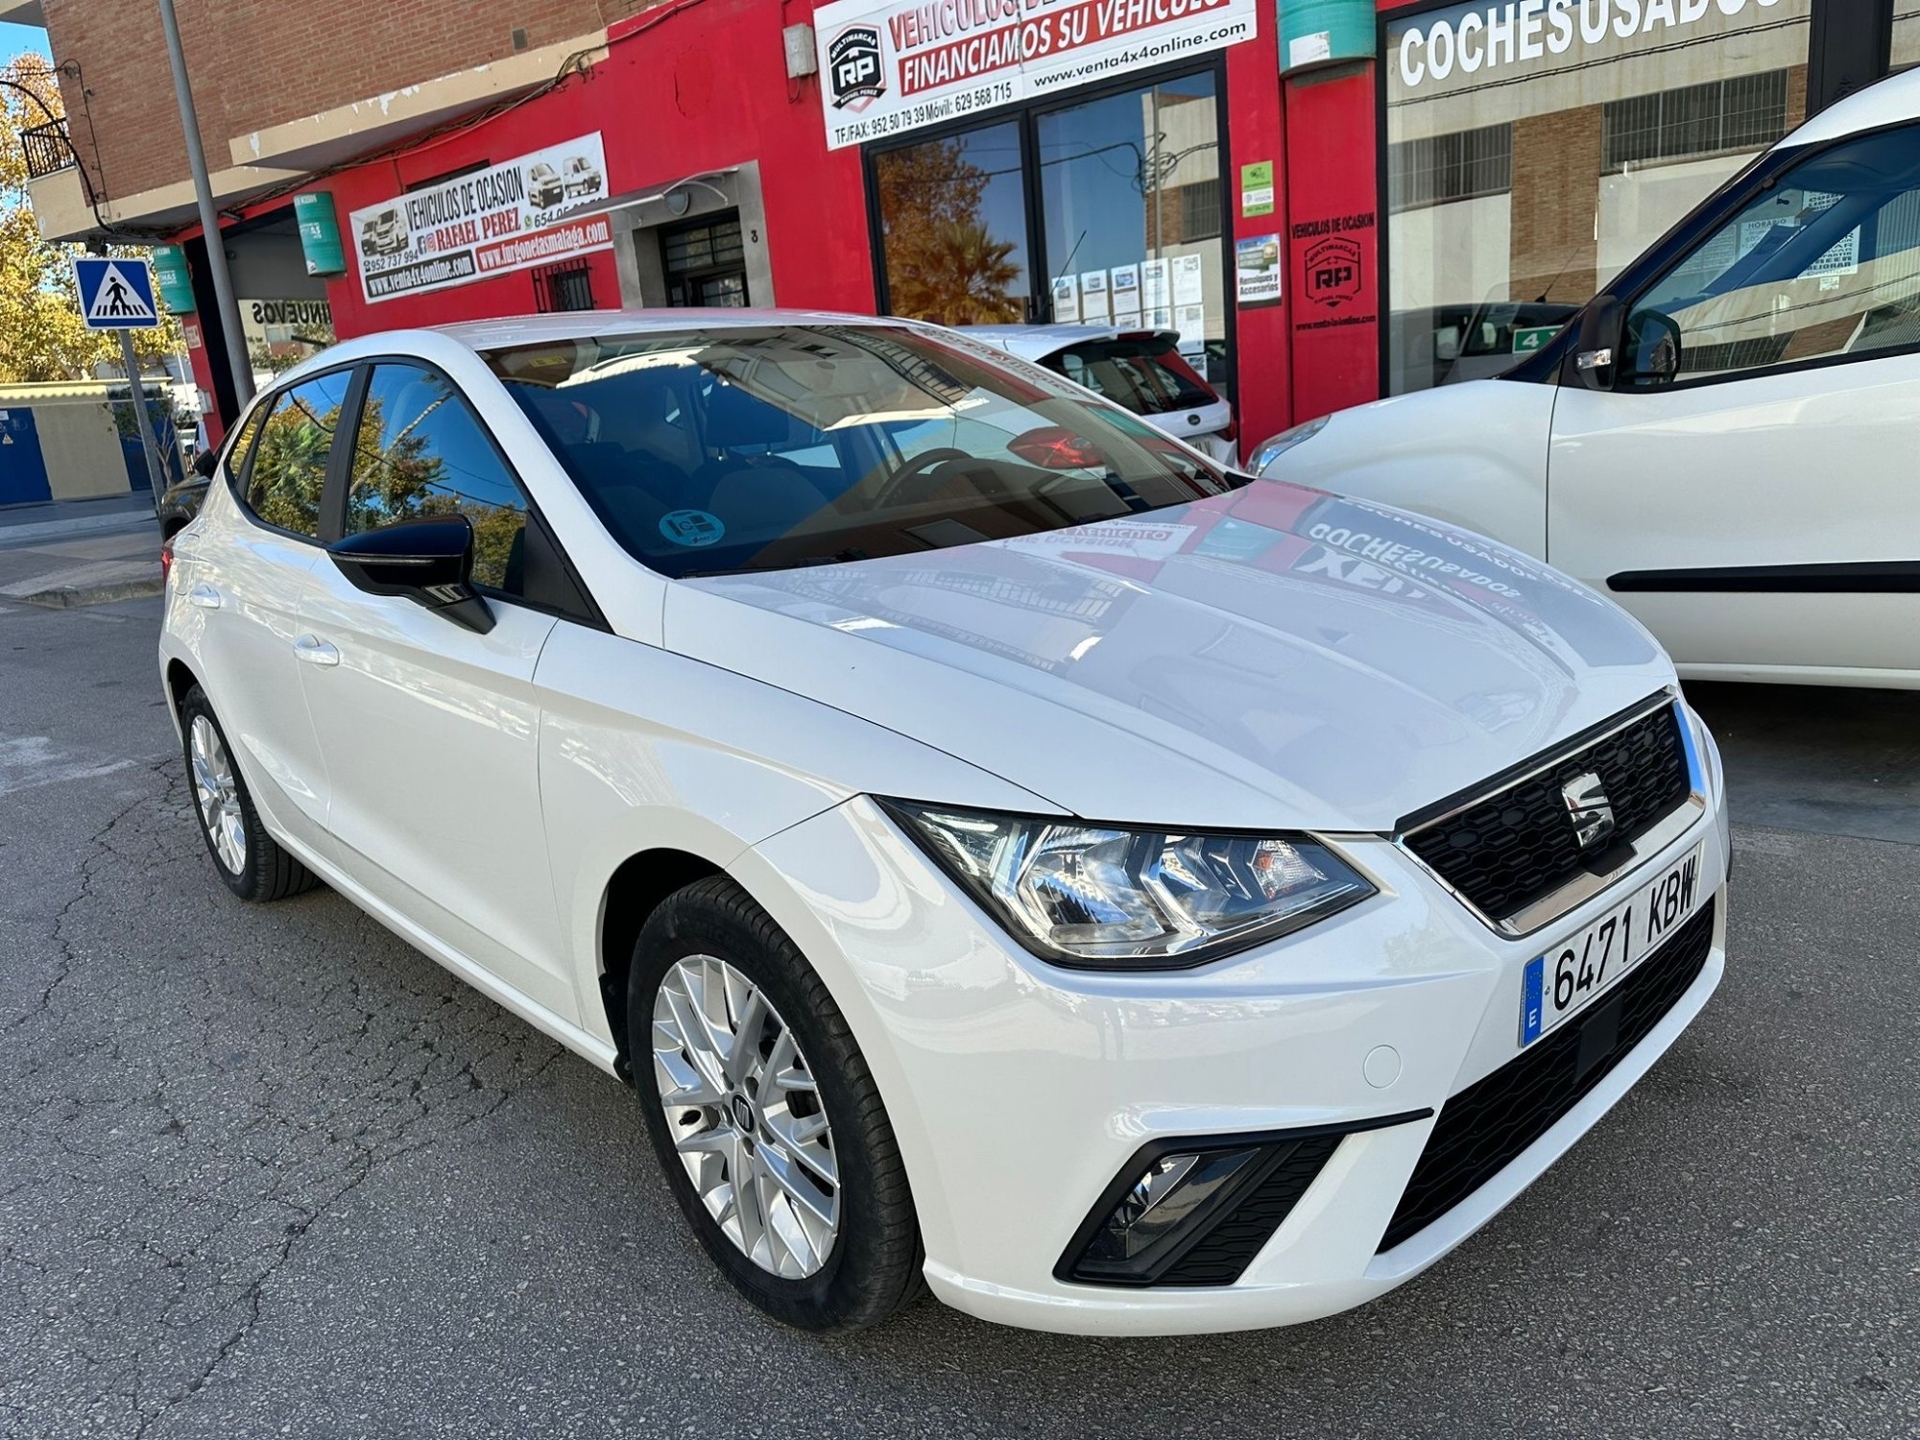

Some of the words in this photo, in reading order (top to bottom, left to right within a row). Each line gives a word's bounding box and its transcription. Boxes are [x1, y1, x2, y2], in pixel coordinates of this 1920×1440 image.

[831, 33, 876, 59] MULTIMARCAS
[904, 18, 1051, 92] FINANCIAMOS
[1057, 6, 1089, 49] SU
[1096, 0, 1218, 36] VEHIC
[1034, 22, 1246, 87] www.venta4x4online.com
[1399, 0, 1780, 87] COCHESUSA
[838, 55, 875, 88] RP
[871, 118, 887, 135] 952
[889, 115, 900, 131] 50
[901, 111, 912, 127] 79
[914, 106, 925, 123] 39
[925, 101, 953, 121] Móvil:
[955, 94, 972, 112] 629
[975, 89, 991, 107] 568
[993, 82, 1012, 103] 715
[405, 187, 460, 232] VEHICULOS
[461, 181, 477, 219] DE
[476, 166, 525, 212] OCASION
[534, 210, 554, 228] 654
[435, 220, 480, 252] RAFAEL
[482, 207, 522, 238] PEREZ
[479, 220, 609, 271] www.furgonetasmalaga.com
[1291, 219, 1330, 239] VEHICULOS
[1332, 217, 1341, 233] DE
[1342, 212, 1375, 231] OCASION
[368, 253, 473, 297] www.venta4x4online.com
[370, 258, 386, 273] 952
[387, 253, 402, 268] 737
[403, 248, 419, 264] 994
[1309, 244, 1356, 263] MULTIMARCAS
[1315, 266, 1352, 290] RP
[1554, 905, 1632, 1011] 6471
[1647, 855, 1697, 943] KBW
[1528, 1007, 1538, 1028] E
